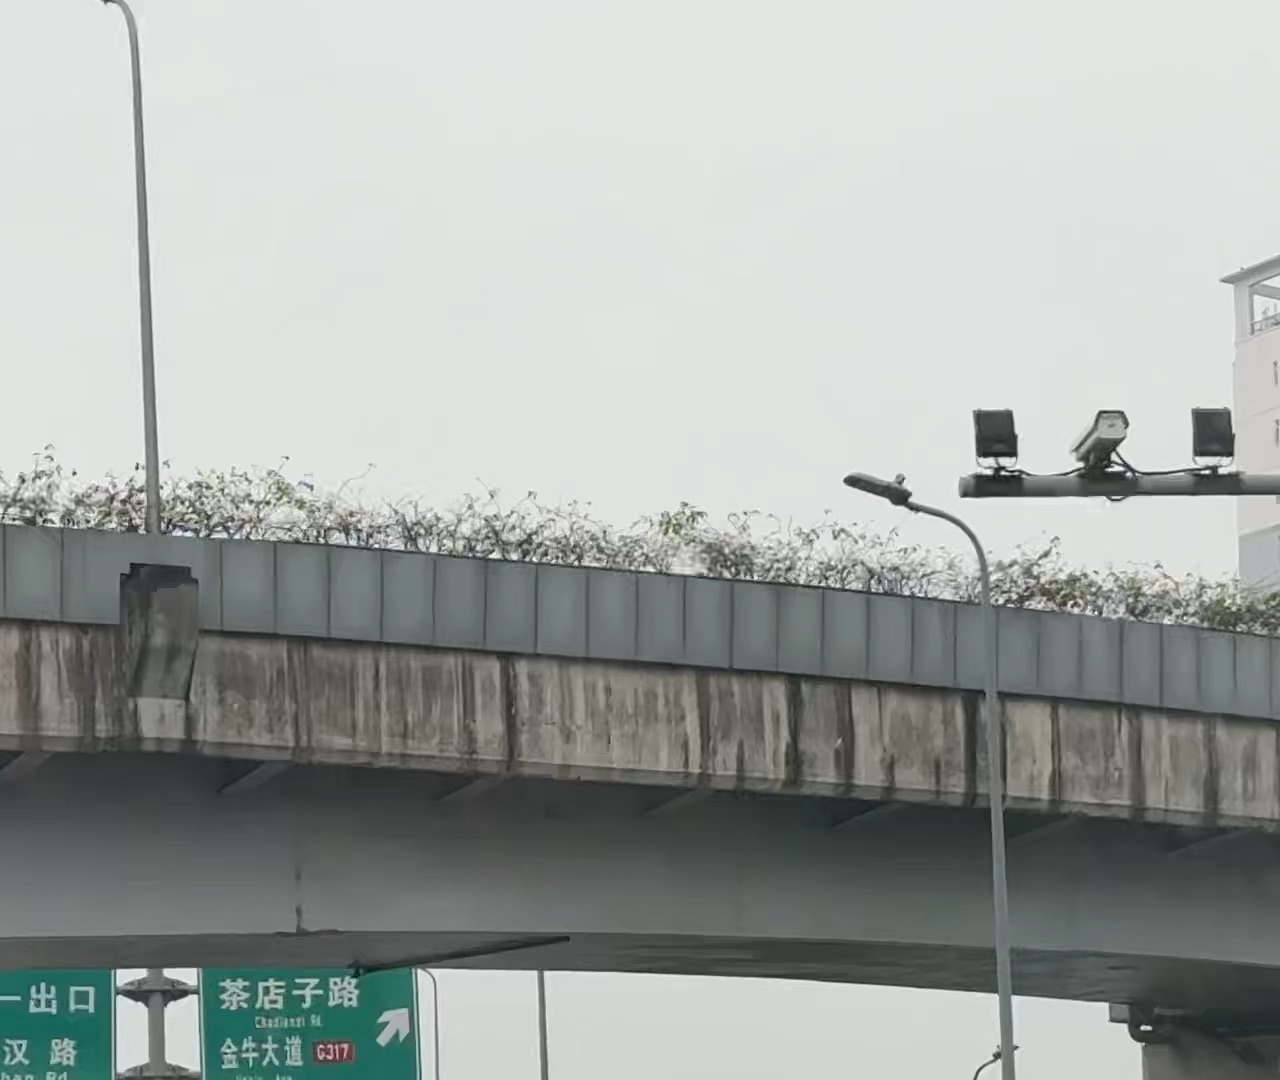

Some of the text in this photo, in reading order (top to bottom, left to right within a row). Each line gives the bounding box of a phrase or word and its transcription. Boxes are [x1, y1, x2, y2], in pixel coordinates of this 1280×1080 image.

[218, 976, 360, 1011] 茶店子路
[220, 1035, 349, 1069] 金牛大道 G317
